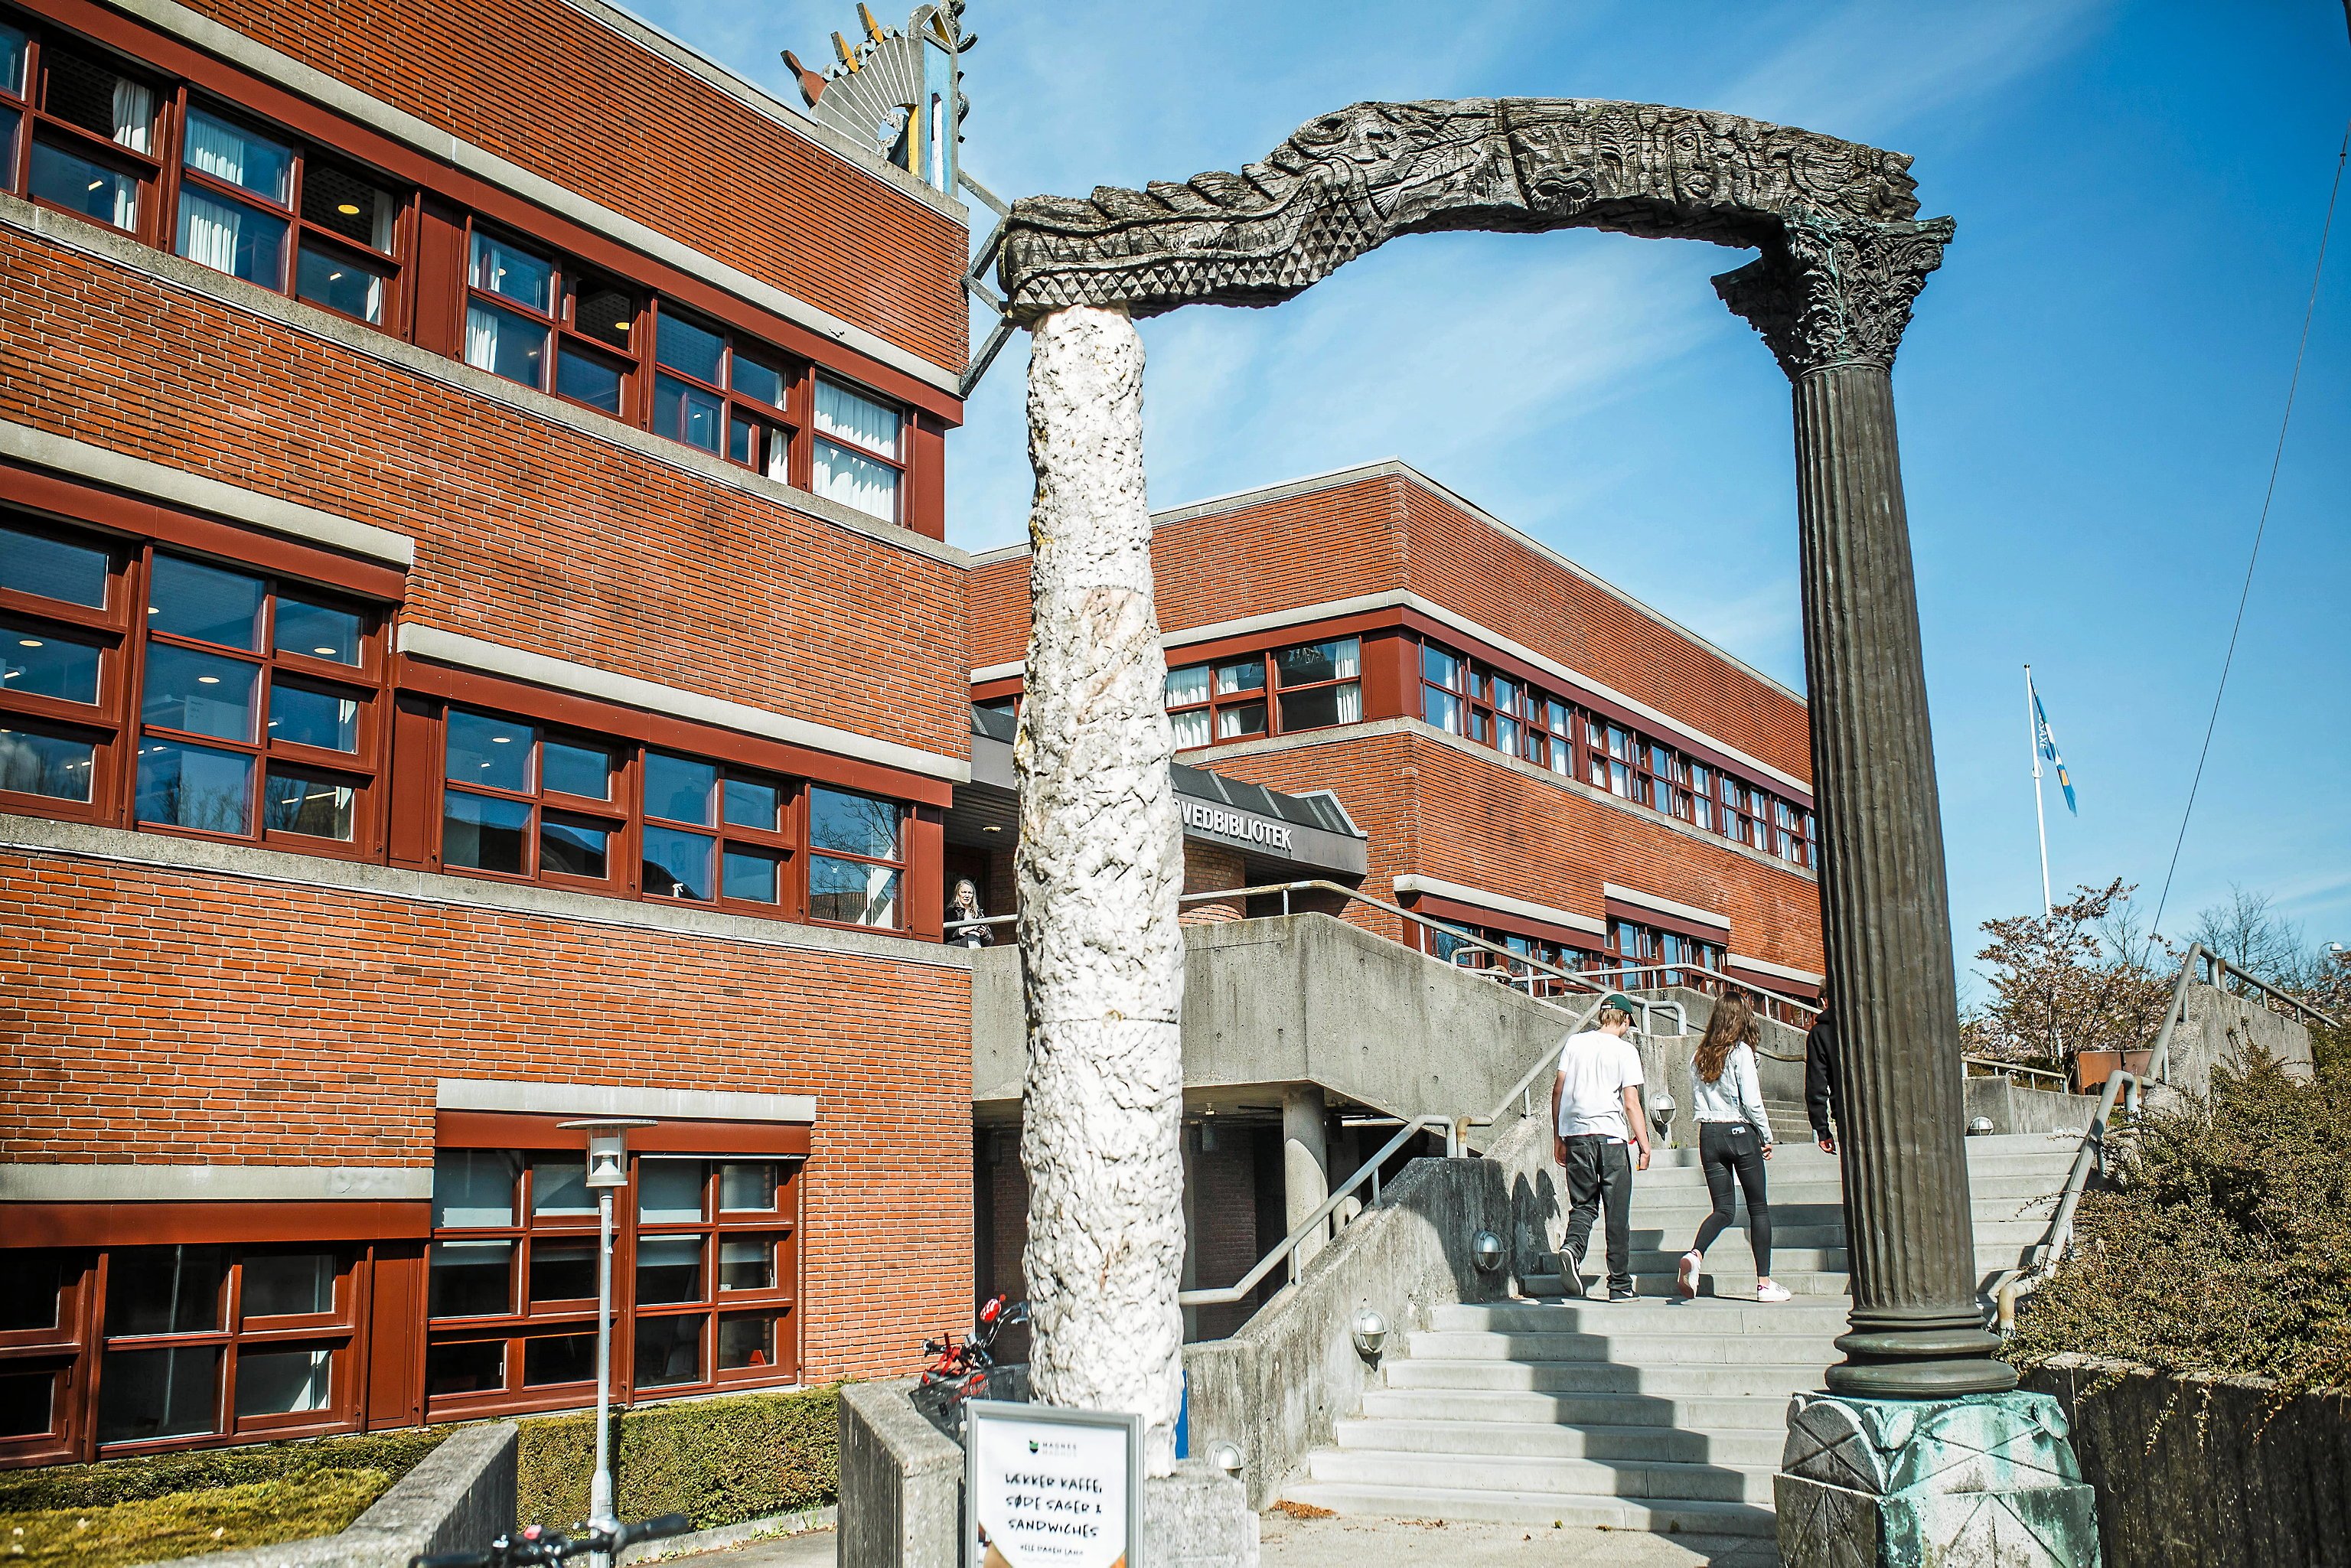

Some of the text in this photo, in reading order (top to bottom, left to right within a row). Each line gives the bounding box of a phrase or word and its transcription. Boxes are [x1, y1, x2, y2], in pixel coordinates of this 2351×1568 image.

[1005, 1472, 1102, 1494] LÆKKER KAFFE,
[1006, 1494, 1041, 1511] SØDE
[1046, 1500, 1090, 1514] SAGER
[1008, 1519, 1100, 1538] SANDWICHES
